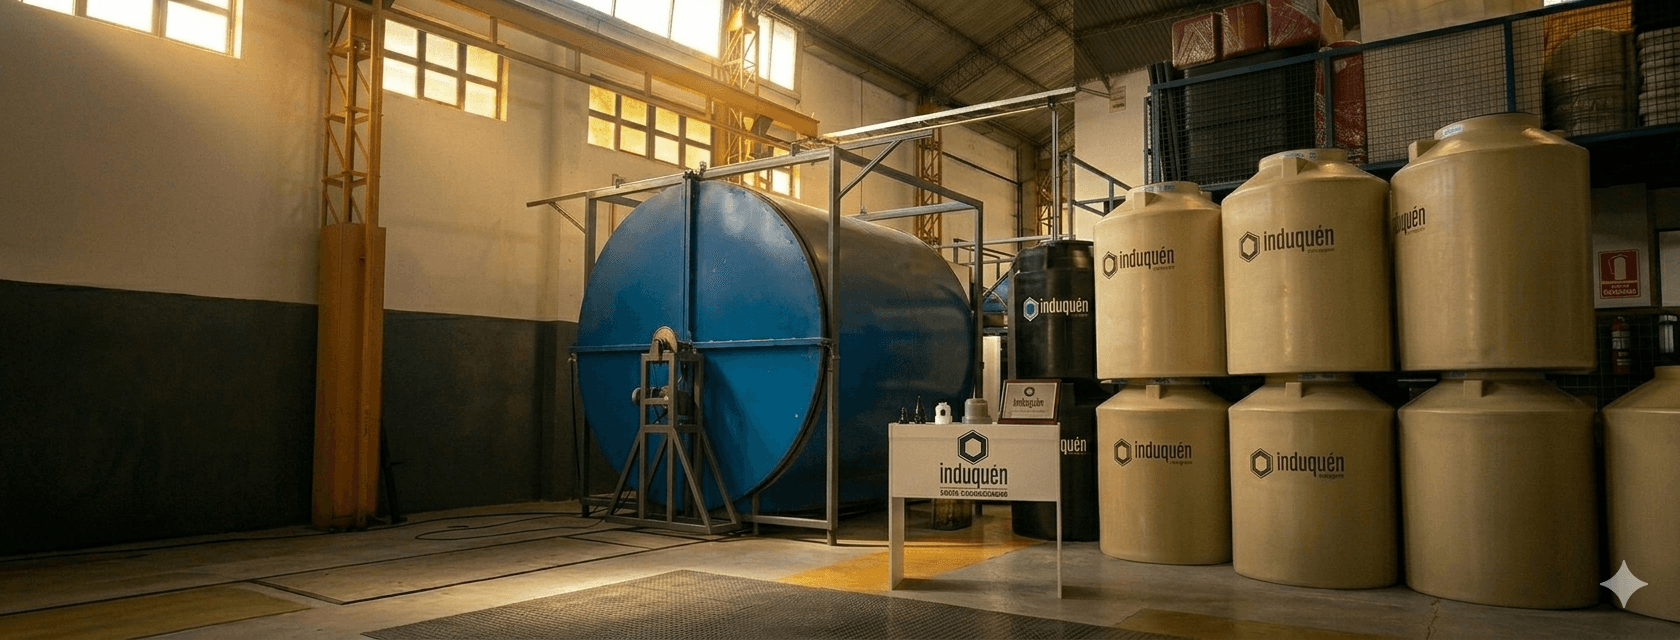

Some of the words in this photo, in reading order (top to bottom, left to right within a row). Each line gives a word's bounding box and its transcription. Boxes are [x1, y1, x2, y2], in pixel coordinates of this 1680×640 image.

[1263, 224, 1335, 252] induquén
[1119, 246, 1175, 270] induquén
[1040, 297, 1089, 316] induquén
[1060, 436, 1087, 456] quén
[1134, 440, 1192, 463] induquén
[939, 462, 1008, 489] induquén
[1276, 451, 1345, 478] induquén
